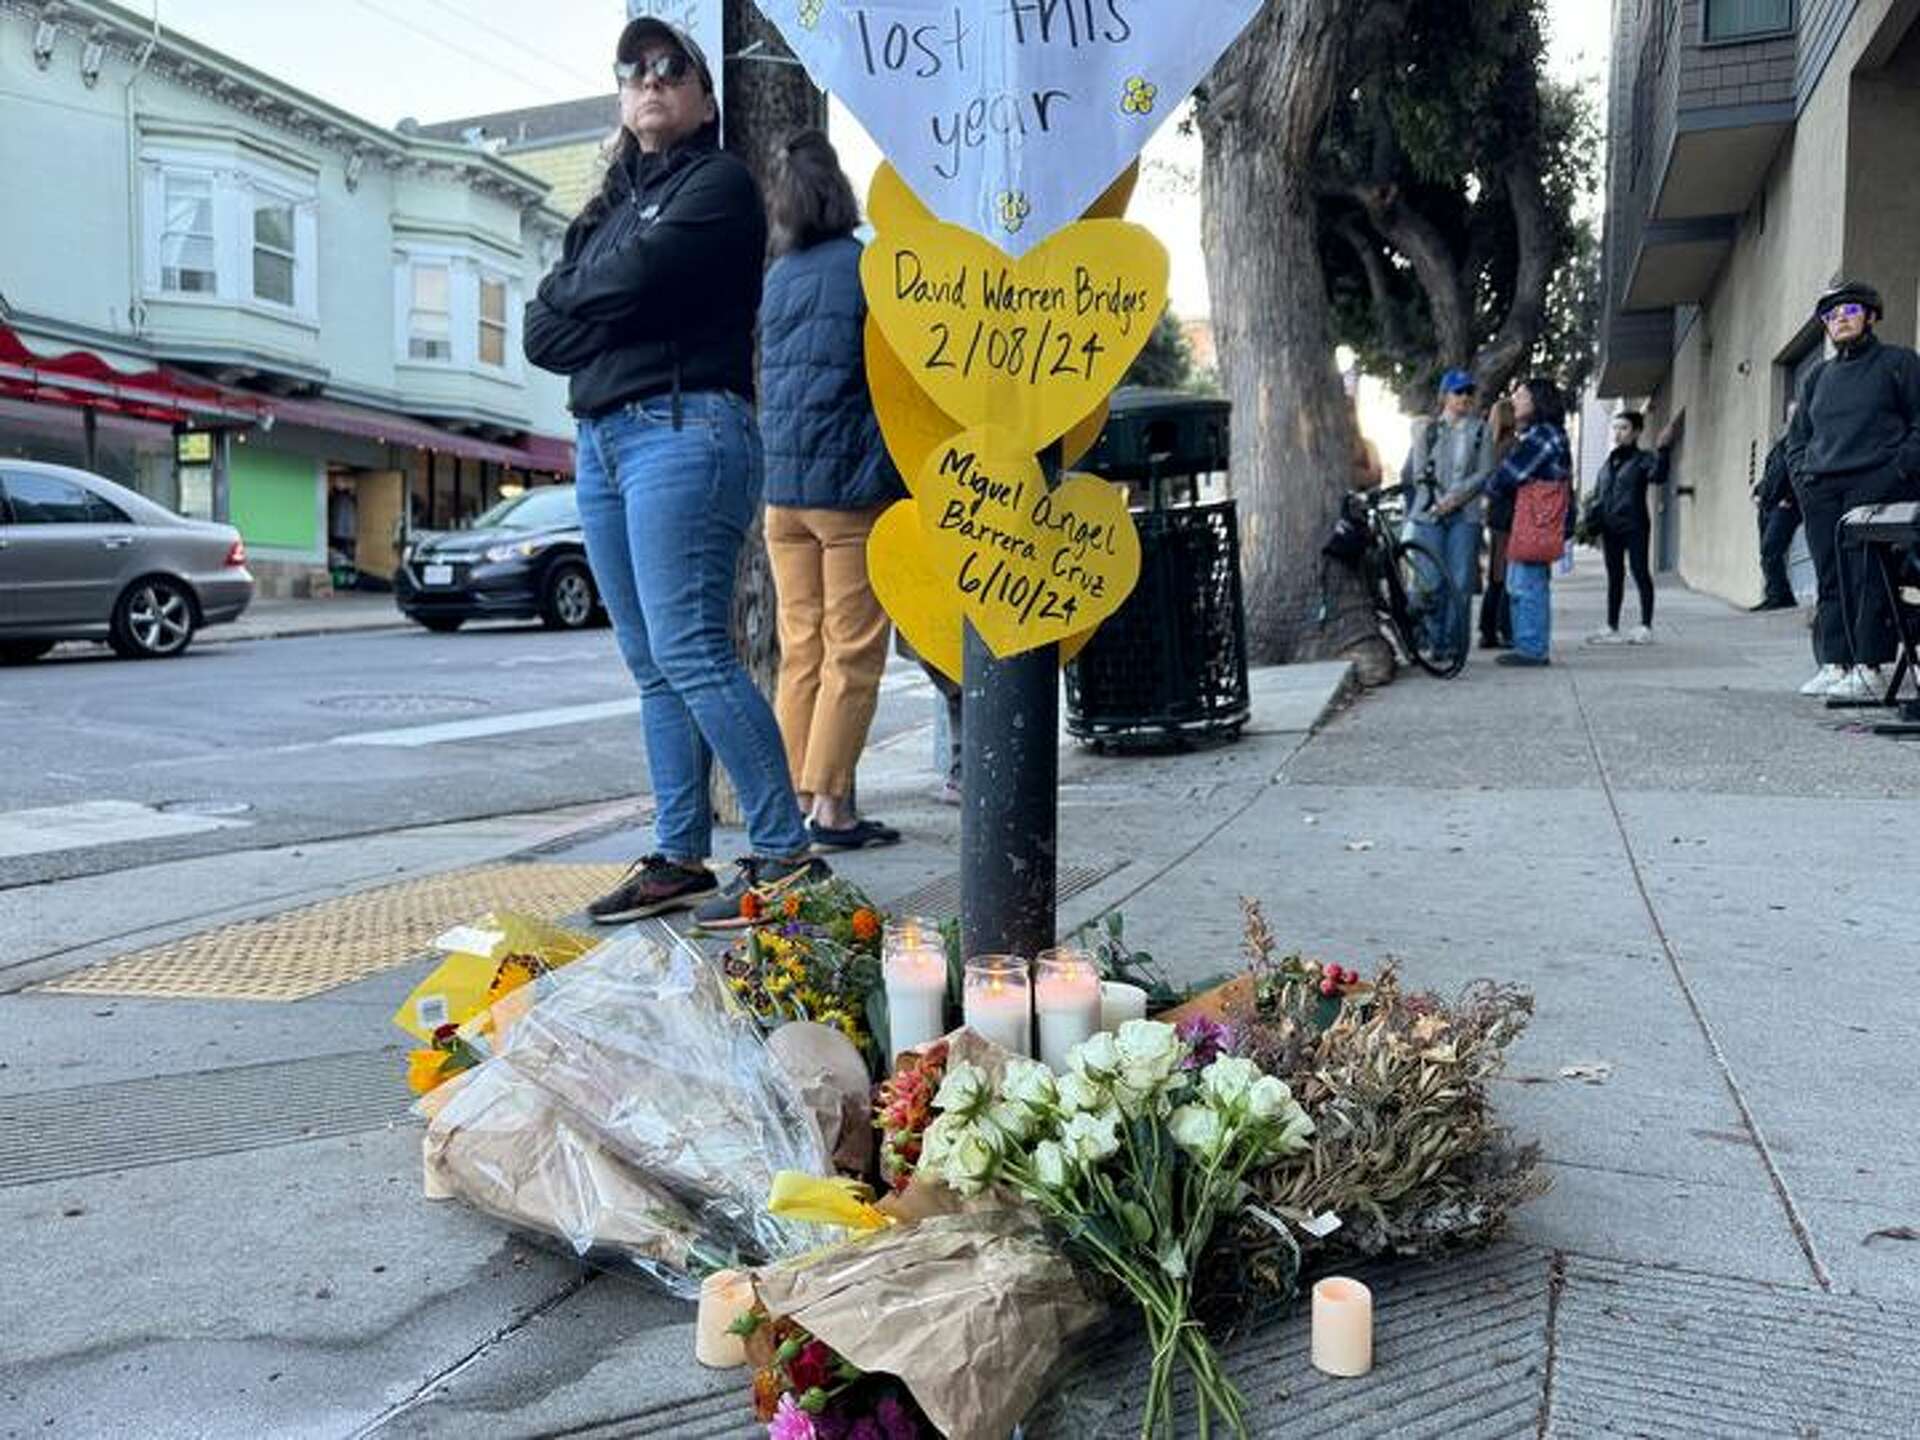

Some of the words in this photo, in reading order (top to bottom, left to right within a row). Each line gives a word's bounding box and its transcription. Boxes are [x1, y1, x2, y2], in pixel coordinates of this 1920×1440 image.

[858, 8, 968, 77] lost
[1000, 0, 1131, 47] this
[932, 90, 1071, 180] year
[895, 249, 967, 310] David
[983, 267, 1065, 314] Warren
[925, 319, 1105, 385] 2/08/24
[938, 447, 1025, 517] Miguel
[938, 499, 1037, 561] Barrera
[1052, 547, 1105, 598] Cruz
[957, 551, 1078, 626] 6/10/24
